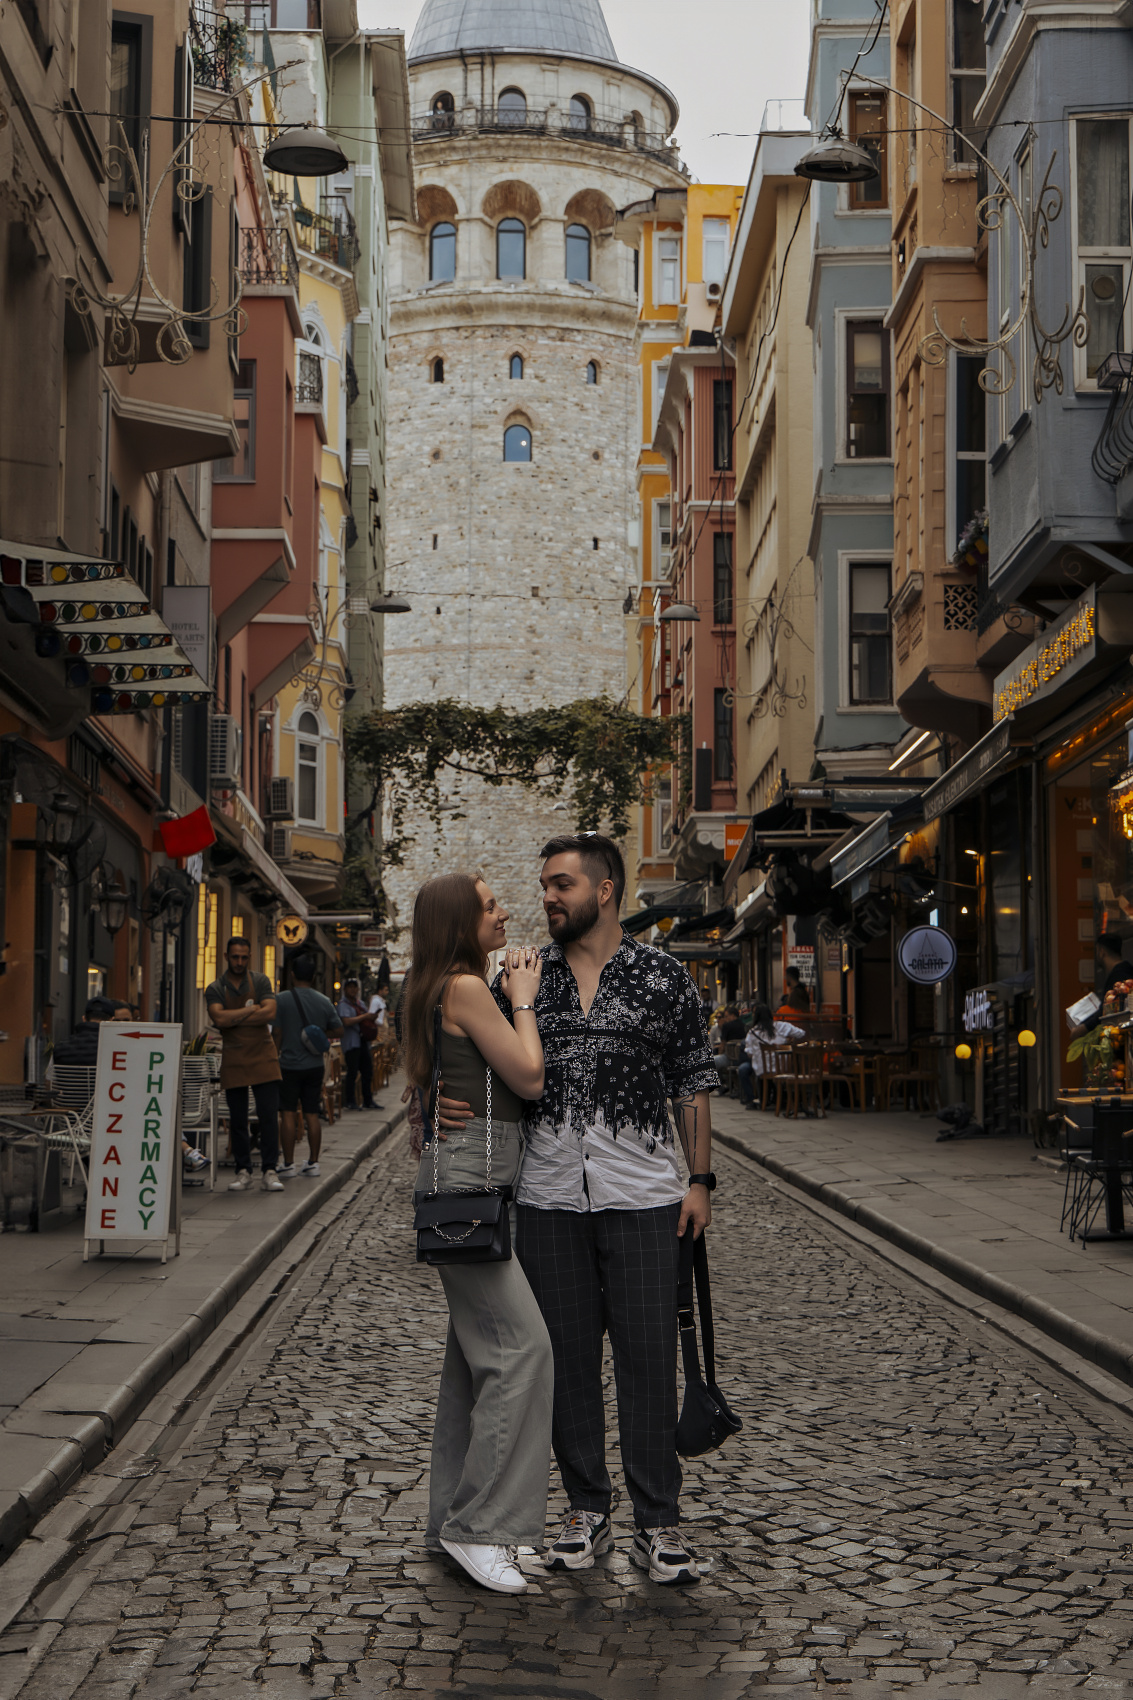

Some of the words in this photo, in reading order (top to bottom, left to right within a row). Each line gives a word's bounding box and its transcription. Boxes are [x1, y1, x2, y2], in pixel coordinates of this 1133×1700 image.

[171, 622, 200, 631] HOTEL
[184, 633, 206, 642] ARTS
[911, 957, 944, 971] GALATA
[101, 1052, 126, 1229] ECZANE
[139, 1052, 164, 1229] PHARMACY
